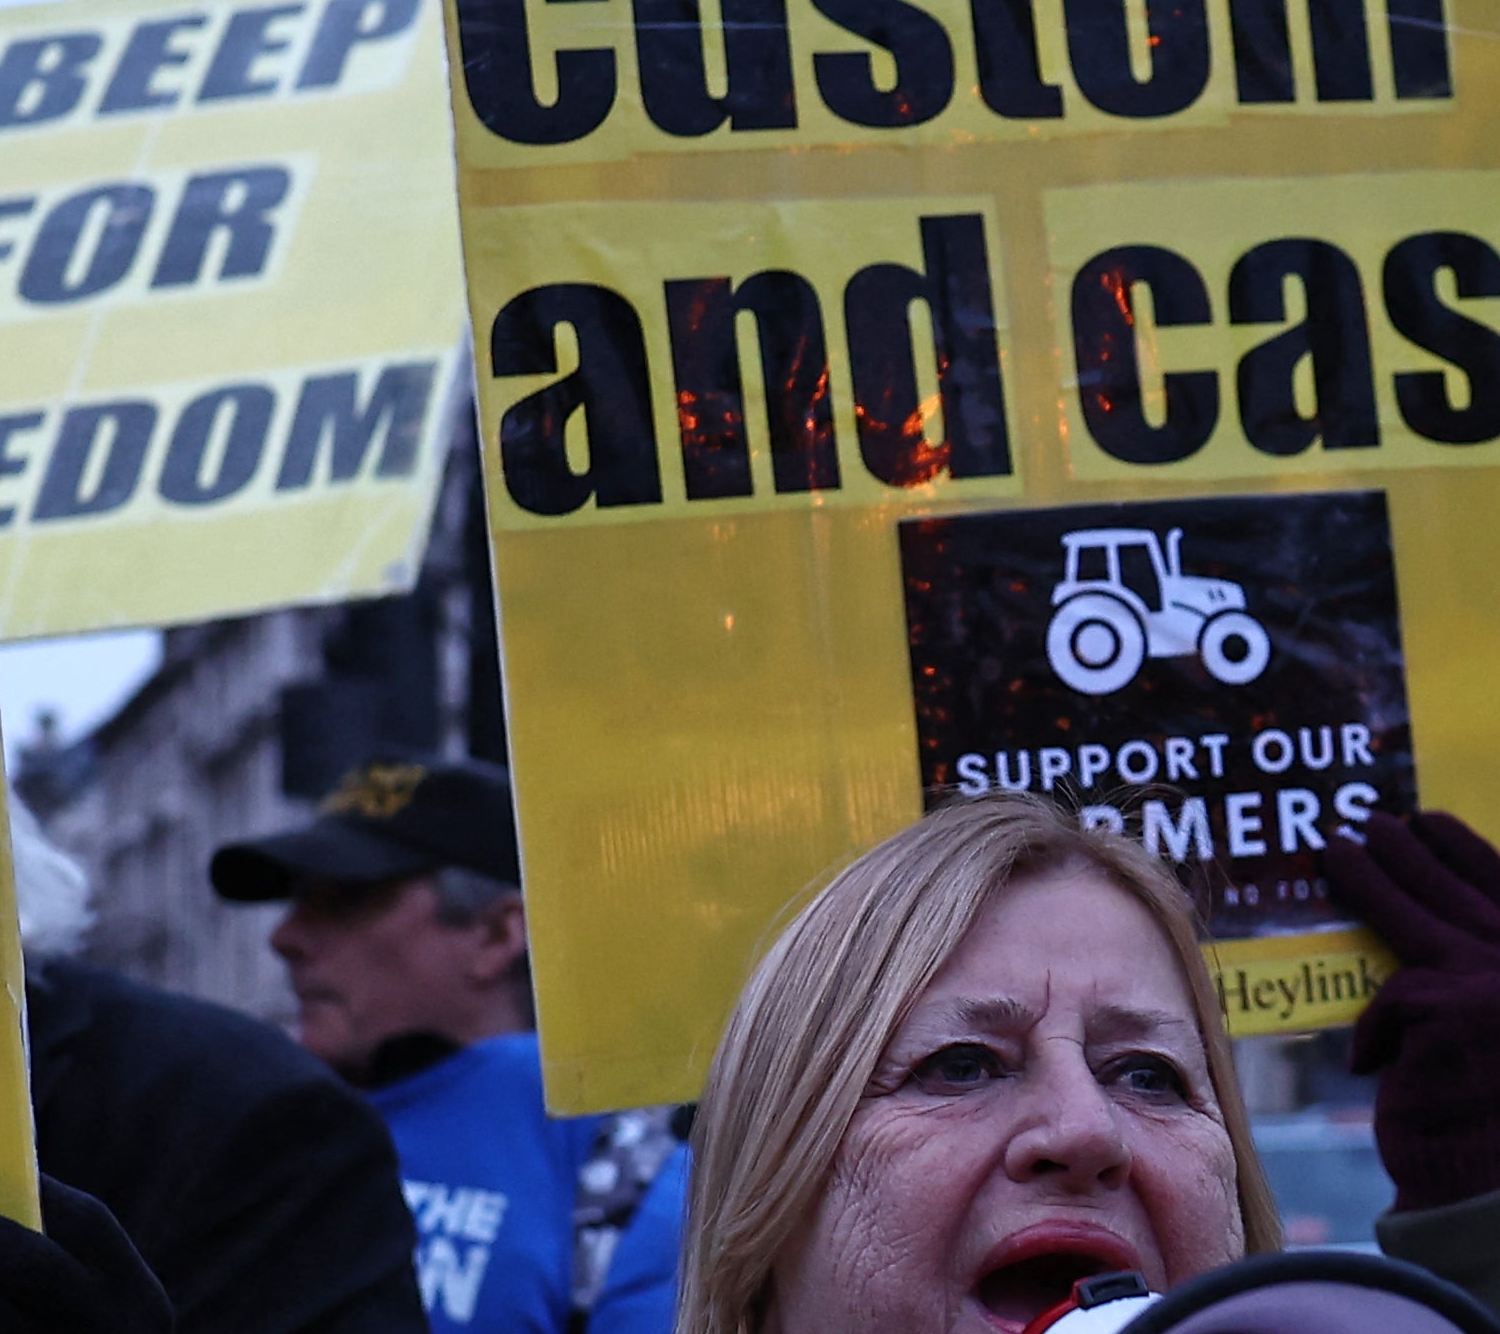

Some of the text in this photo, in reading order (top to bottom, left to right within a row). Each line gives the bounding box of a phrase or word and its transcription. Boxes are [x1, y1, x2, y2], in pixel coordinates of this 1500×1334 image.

[490, 213, 1013, 517] and
[957, 723, 1375, 796] SUPPORT OUR
[1082, 782, 1379, 862] MERS
